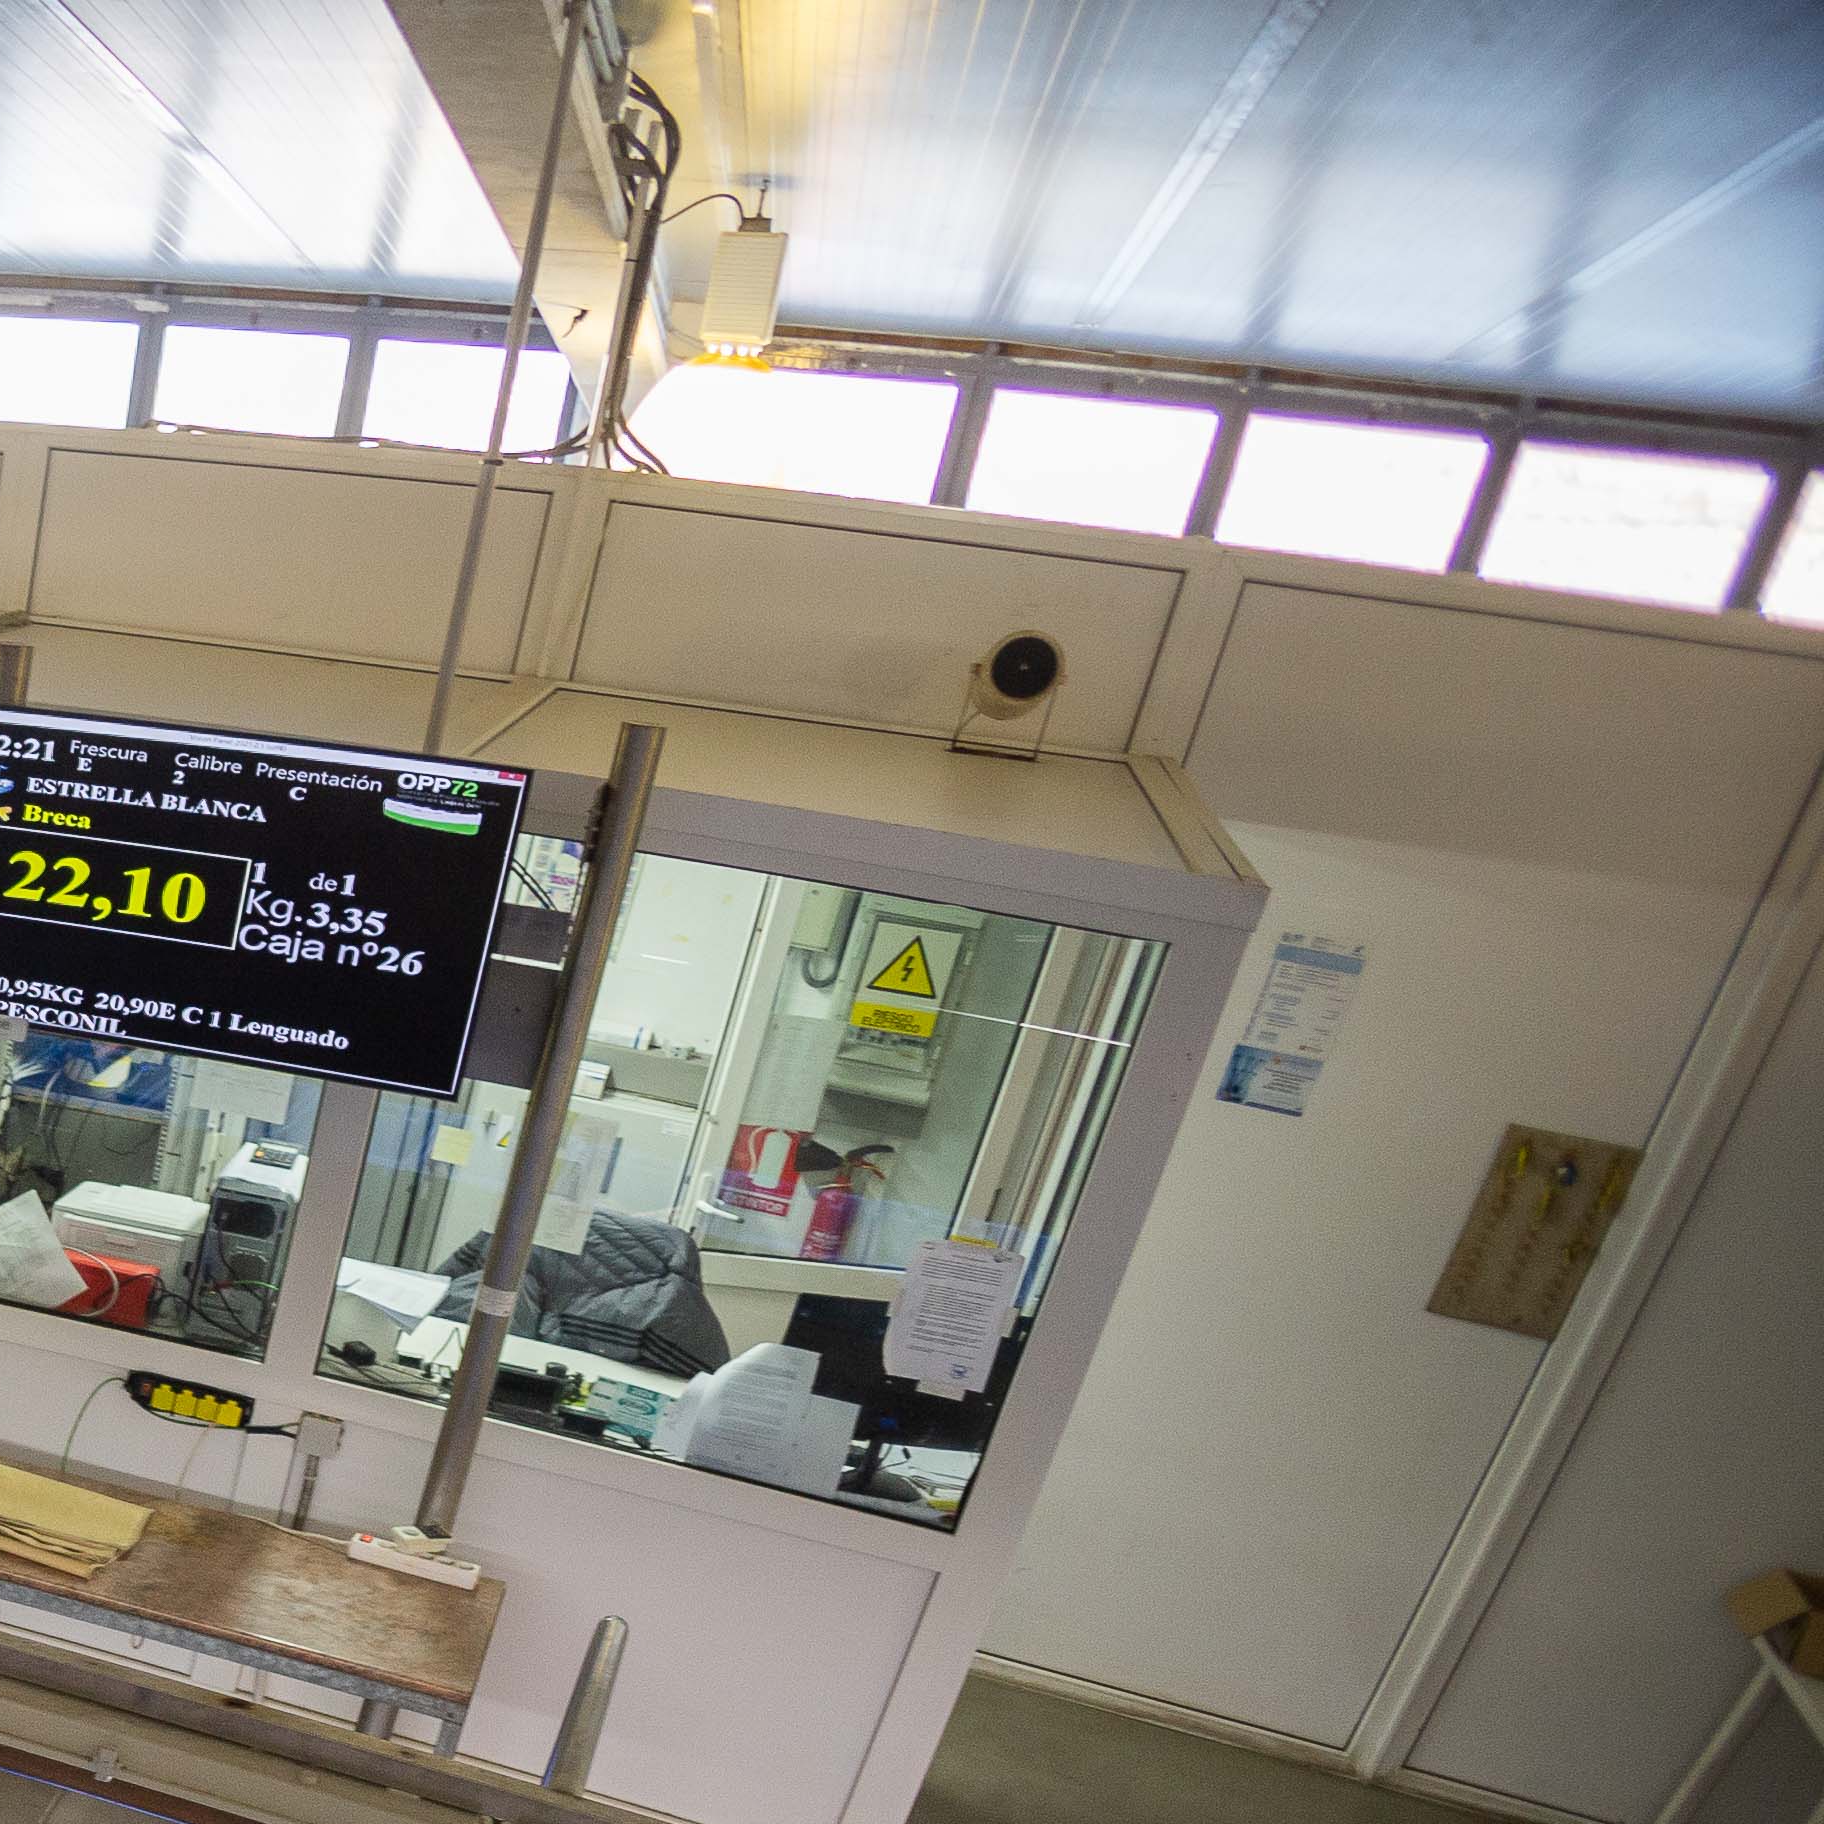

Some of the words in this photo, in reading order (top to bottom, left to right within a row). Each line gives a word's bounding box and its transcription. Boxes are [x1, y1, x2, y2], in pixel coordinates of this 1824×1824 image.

[70, 740, 148, 763] Frescura
[175, 752, 243, 775] Calibre
[256, 763, 383, 793] Presentación
[77, 757, 92, 772] E
[172, 771, 185, 784] 2
[289, 786, 307, 802] C
[397, 772, 479, 798] OPP72
[22, 804, 91, 830] Breca
[26, 777, 156, 809] ESTRELLA
[162, 793, 267, 824] BLANCA
[2, 850, 206, 923] 22,10
[252, 861, 266, 884] 1
[239, 923, 324, 964] Caja
[94, 991, 175, 1021] 20,90E
[182, 1006, 201, 1025] C
[209, 1009, 222, 1029] 1
[229, 1012, 350, 1051] Lenguado
